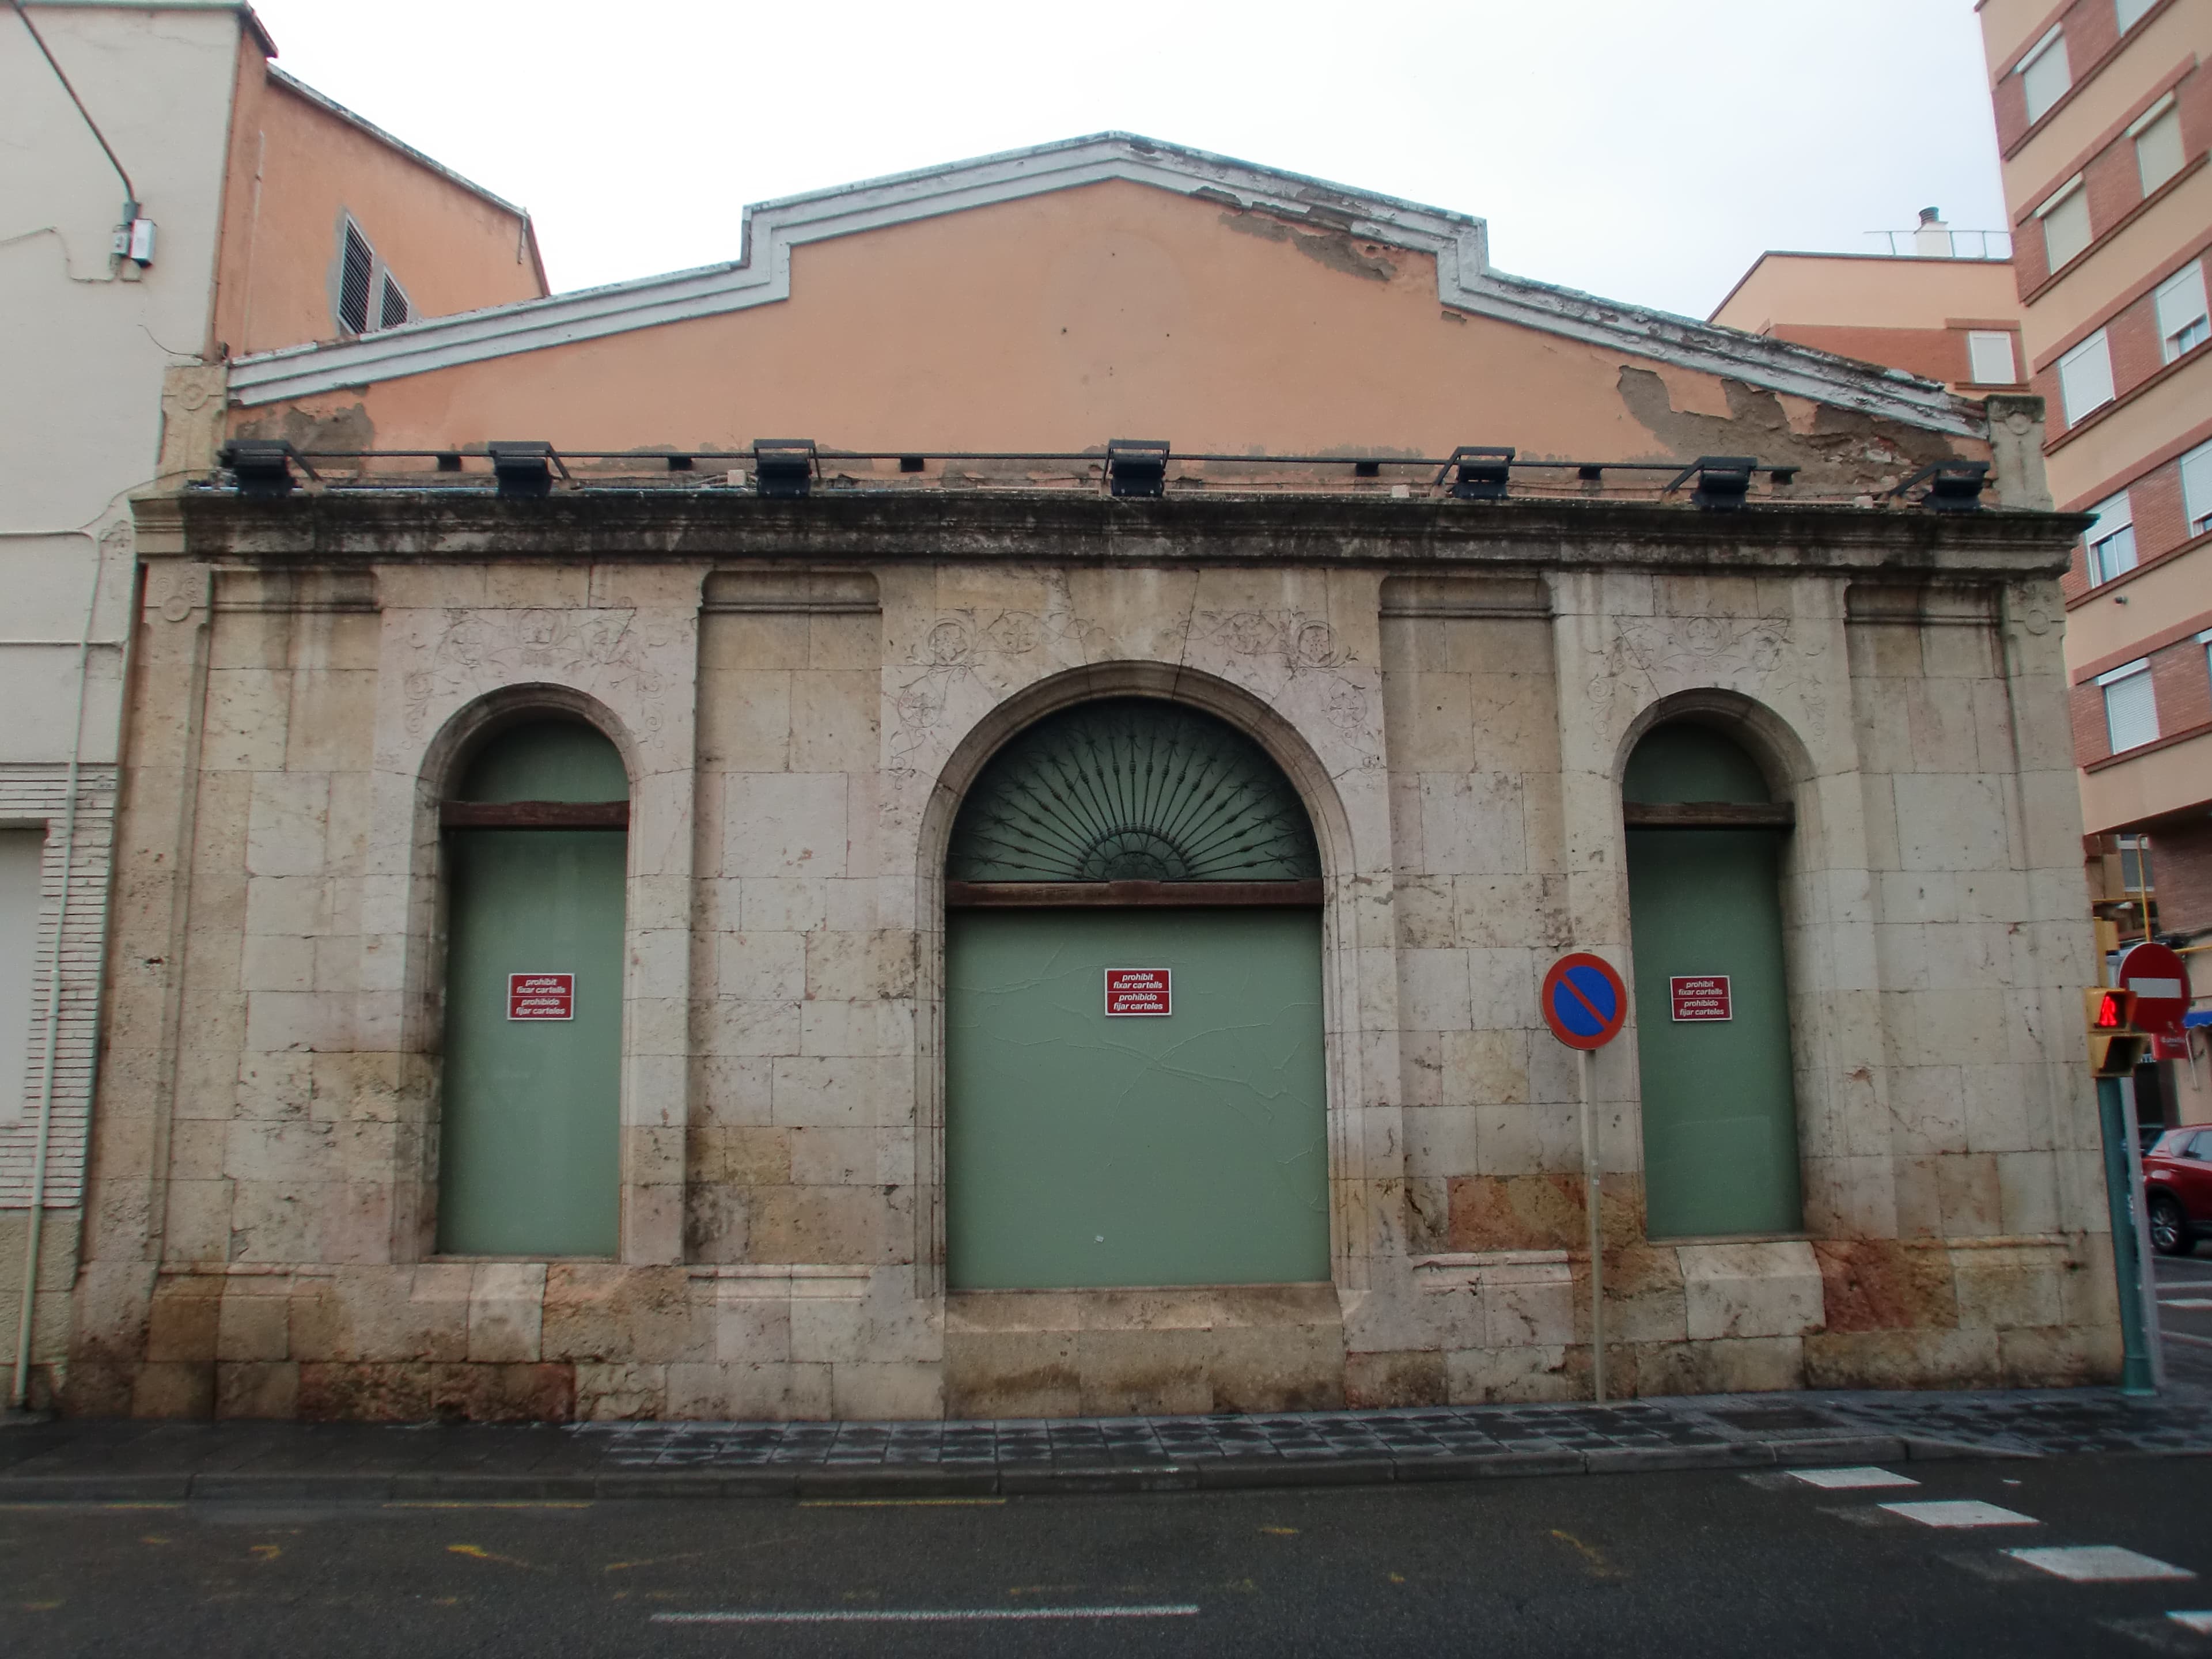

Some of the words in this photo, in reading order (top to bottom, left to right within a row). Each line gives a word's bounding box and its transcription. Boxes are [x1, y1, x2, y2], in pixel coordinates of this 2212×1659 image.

[1122, 973, 1154, 982] prohibit
[525, 978, 557, 986] prohibit
[1685, 980, 1714, 988] prohibit
[521, 998, 560, 1006] prohibido
[1119, 994, 1157, 1002] prohibido
[1113, 1002, 1129, 1011] fijar
[1684, 1000, 1718, 1008] prohibido
[516, 1007, 531, 1016] fijar
[1680, 1009, 1694, 1017] fijar
